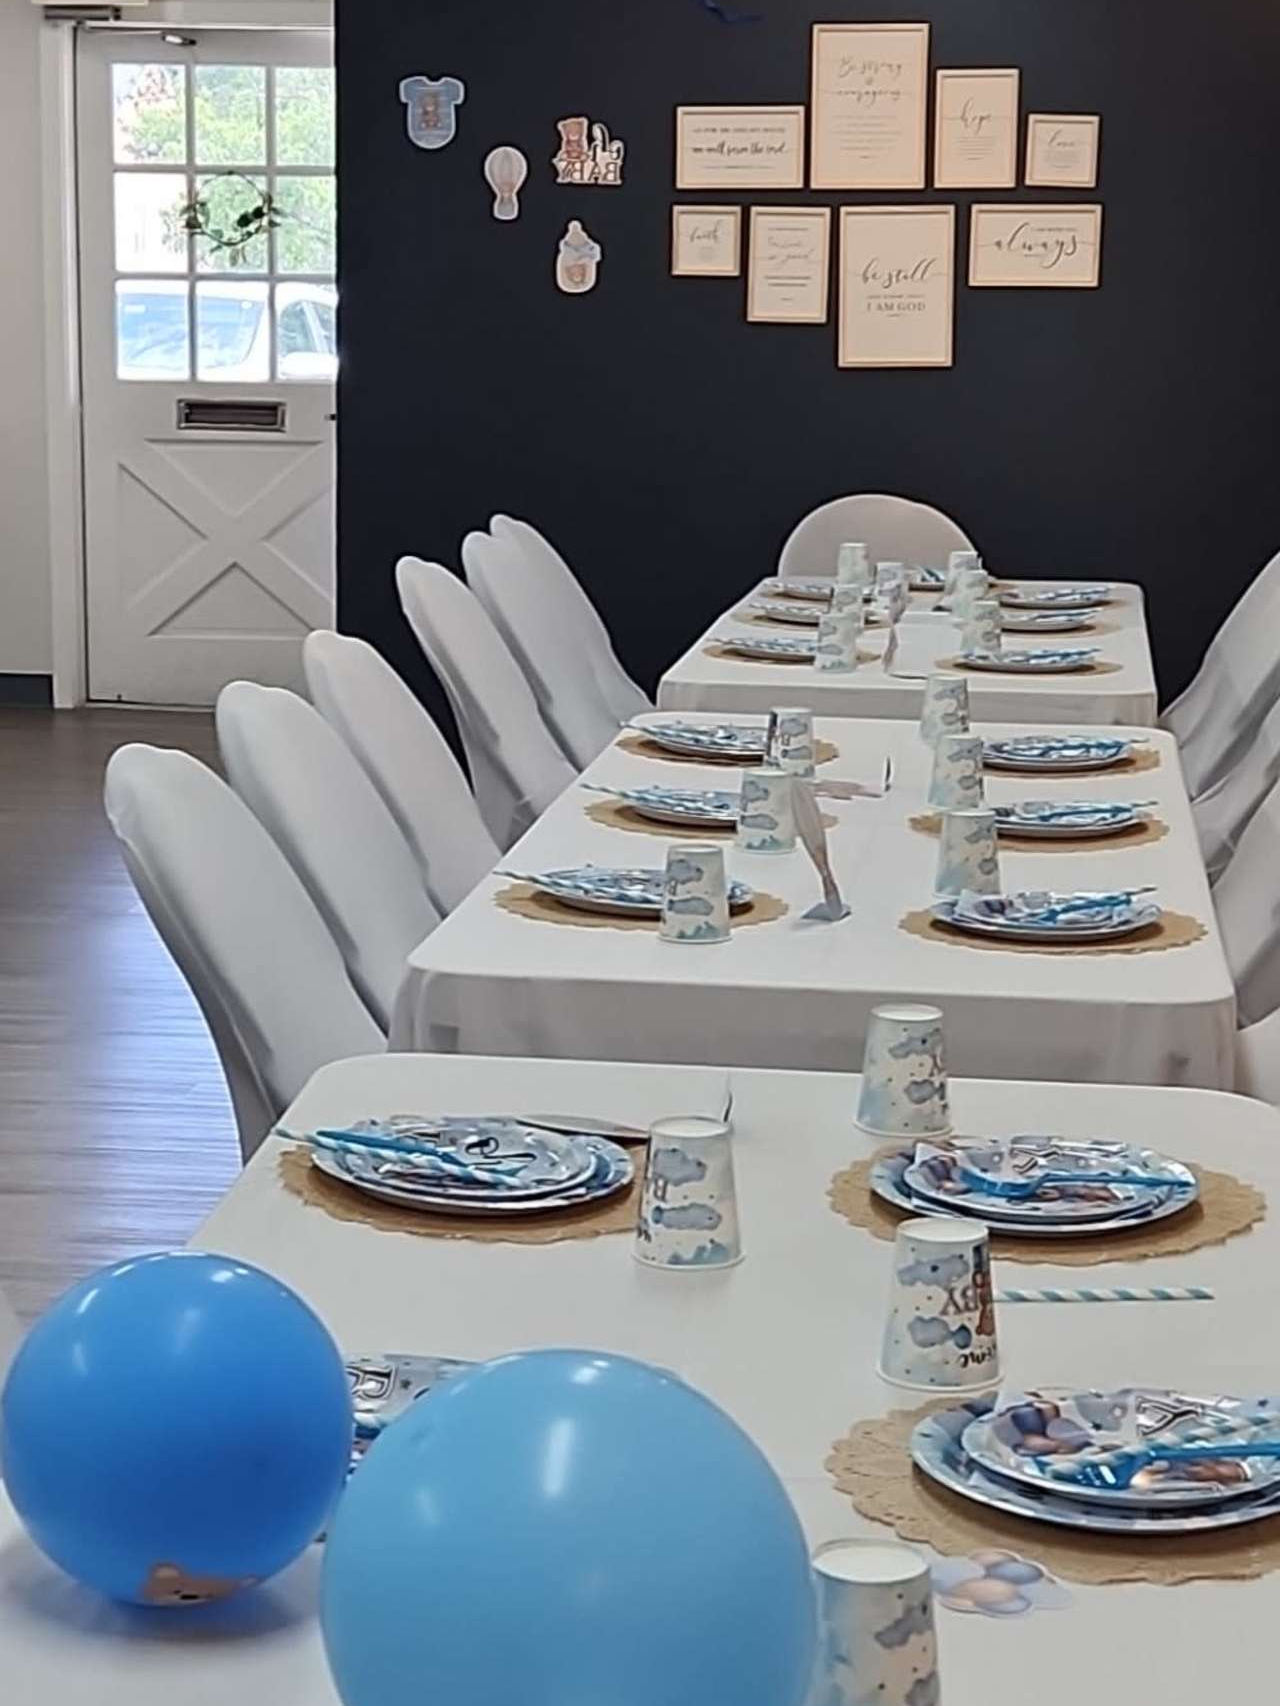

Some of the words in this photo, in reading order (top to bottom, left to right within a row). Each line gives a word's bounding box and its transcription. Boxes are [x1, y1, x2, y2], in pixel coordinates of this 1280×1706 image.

[993, 221, 1079, 270] always
[861, 257, 881, 285] be
[882, 256, 938, 290] still
[896, 301, 927, 312] GOD
